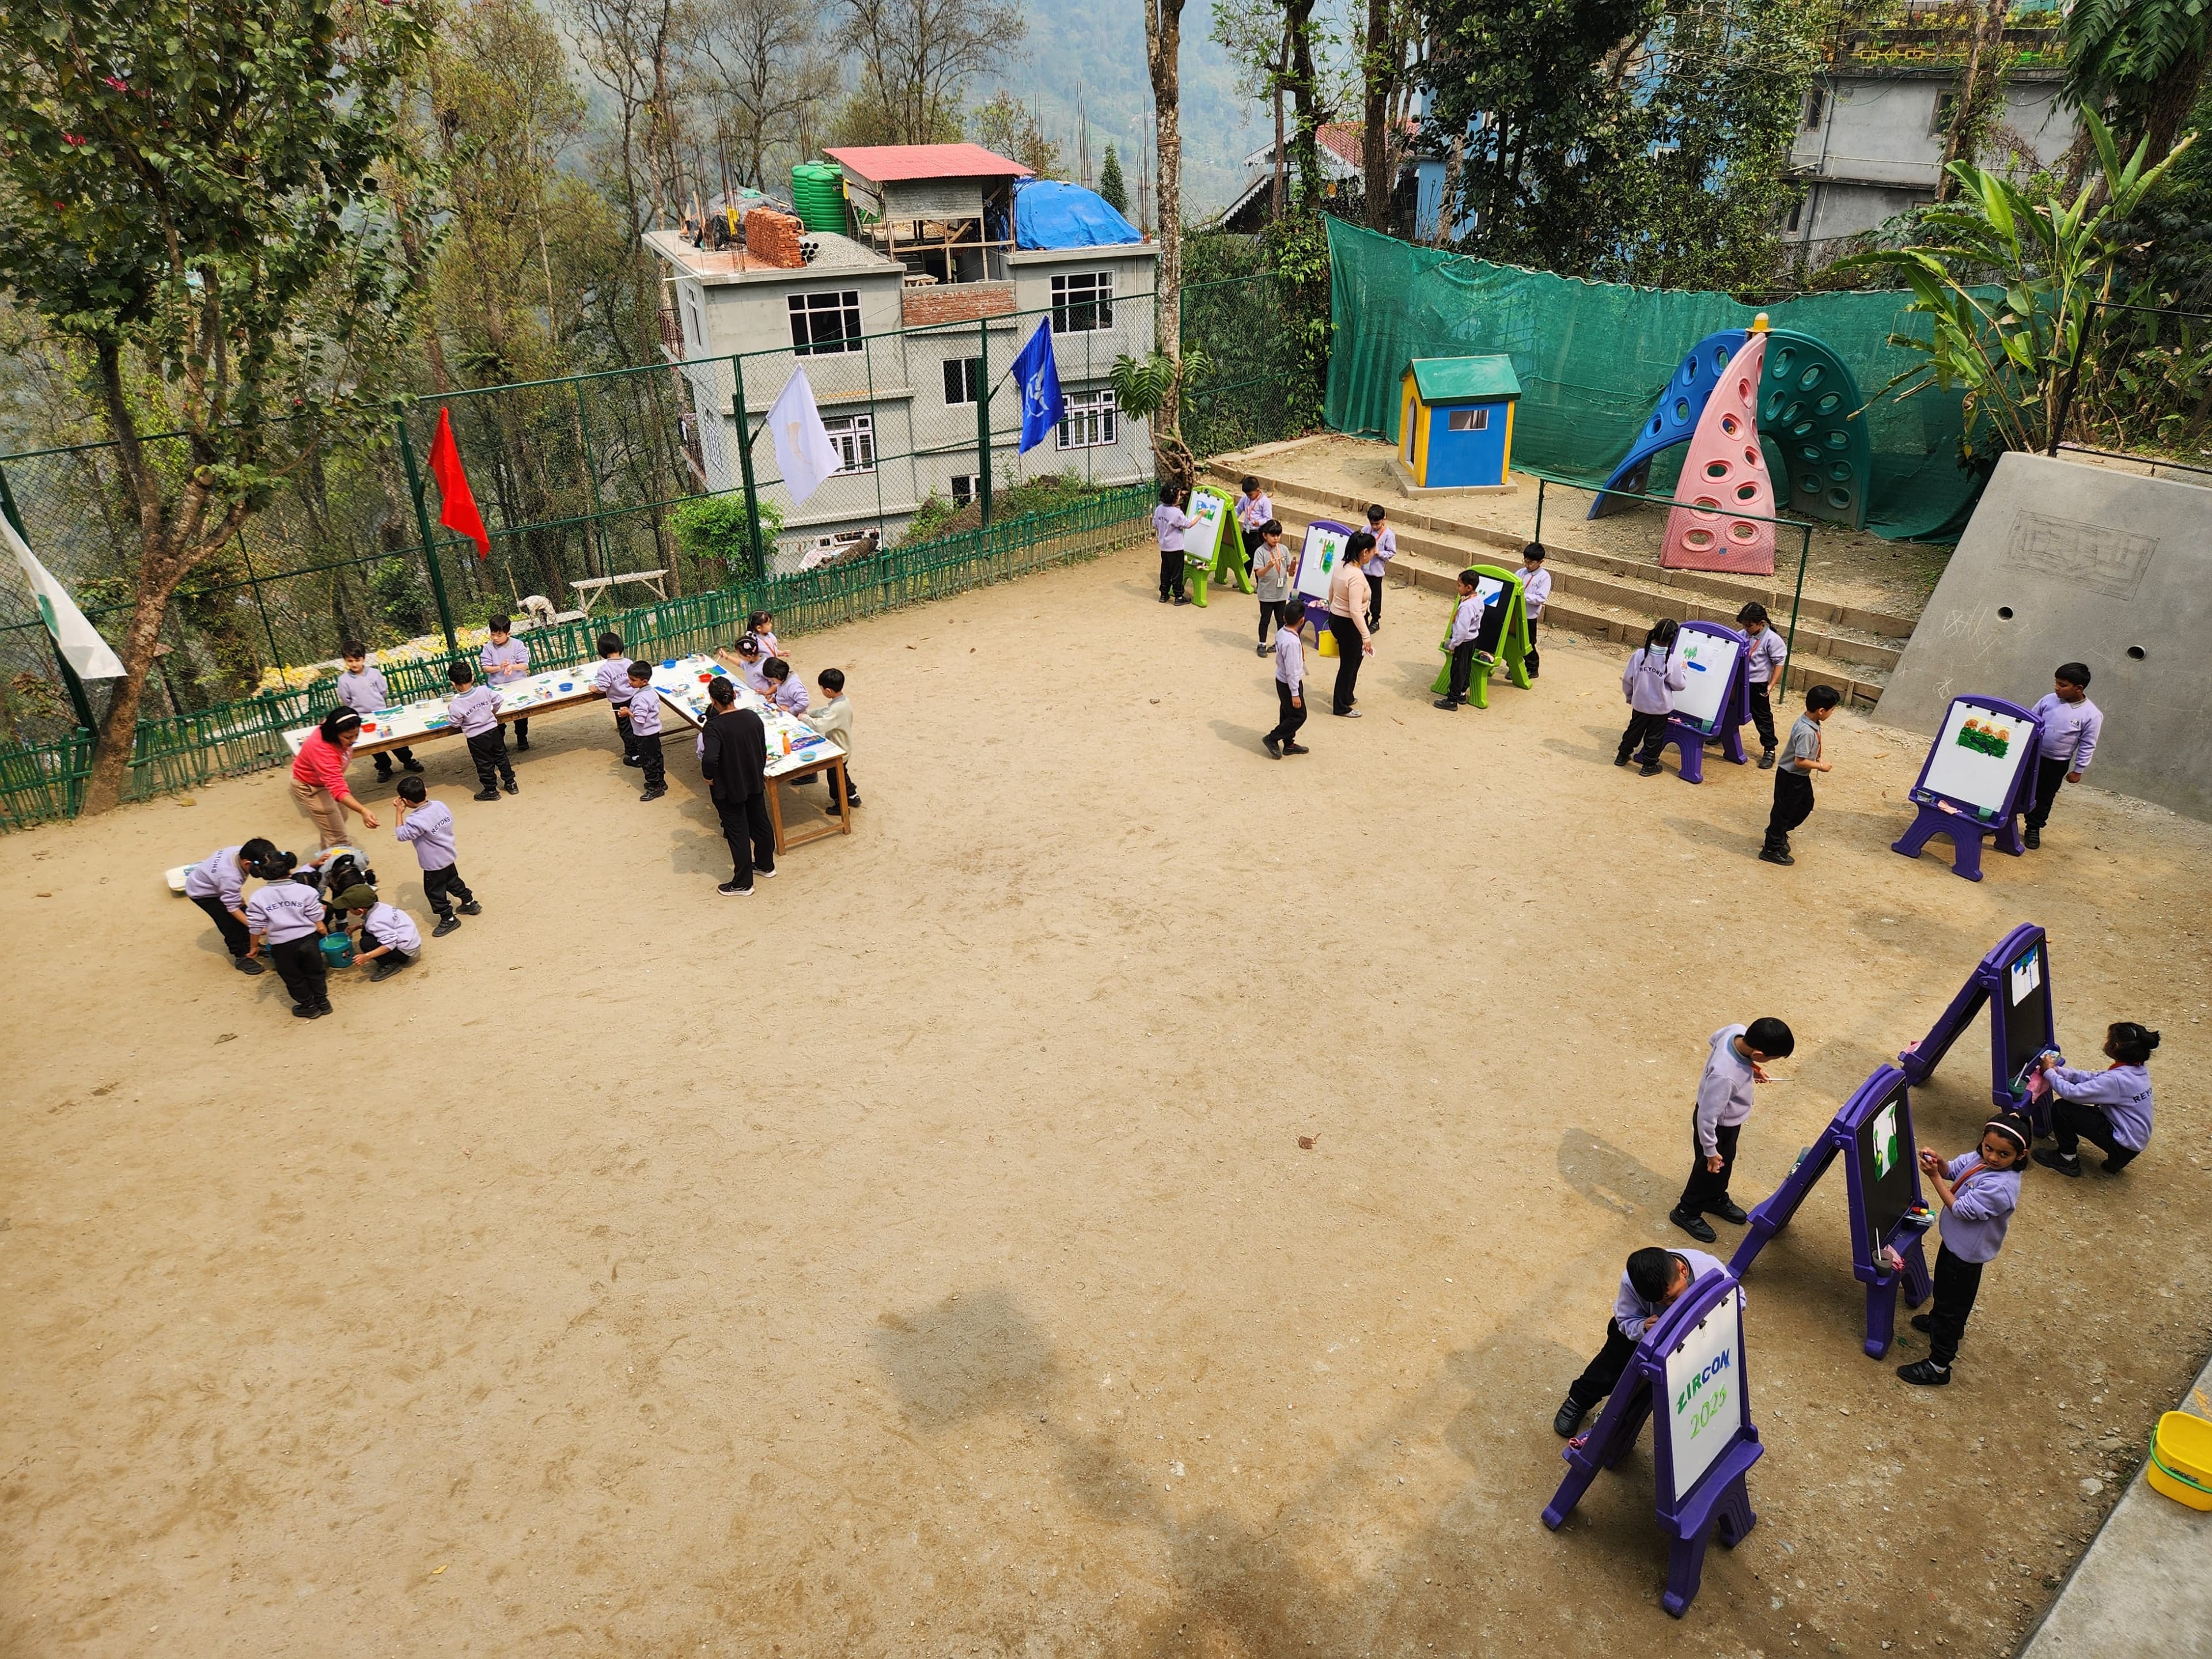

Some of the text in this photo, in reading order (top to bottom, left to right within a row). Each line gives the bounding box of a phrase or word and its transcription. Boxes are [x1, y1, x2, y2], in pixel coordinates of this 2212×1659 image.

[1639, 666, 1664, 677] REYONS
[466, 700, 489, 716] REYONS
[431, 816, 450, 834] REYONS
[266, 900, 304, 912] REYONS
[2133, 1087, 2152, 1103] REYO
[1676, 1348, 1730, 1415] ZIRCON
[1691, 1382, 1727, 1440] 2025
